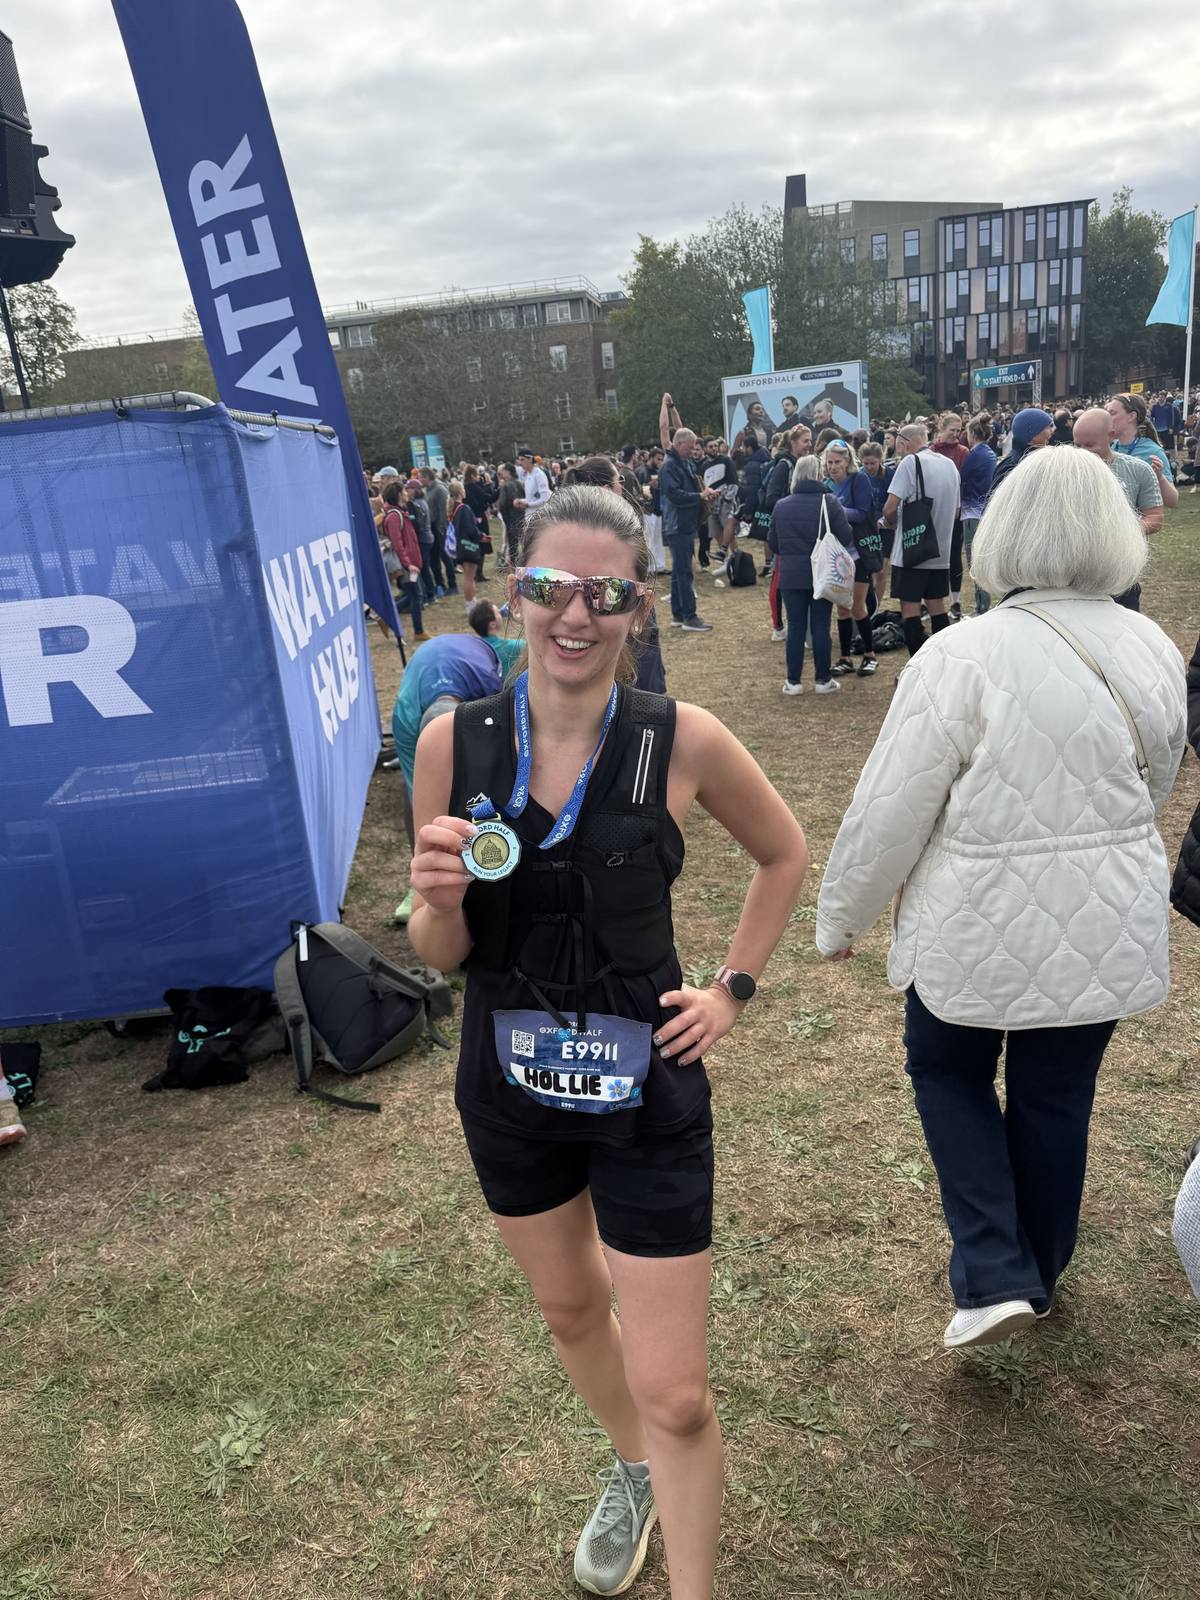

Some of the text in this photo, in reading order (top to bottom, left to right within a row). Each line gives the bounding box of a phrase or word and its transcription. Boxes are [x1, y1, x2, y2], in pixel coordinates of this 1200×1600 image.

[188, 133, 322, 425] ATER
[739, 375, 795, 388] OXFORD HALF
[989, 376, 1002, 384] START
[1002, 374, 1013, 383] PENS
[261, 530, 358, 661] WATER
[310, 625, 360, 746] HUB
[512, 785, 526, 808] 2026
[493, 824, 511, 836] HALF
[539, 1026, 578, 1036] OXFD
[561, 1040, 618, 1061] E9911
[524, 1067, 602, 1096] HOLLIE
